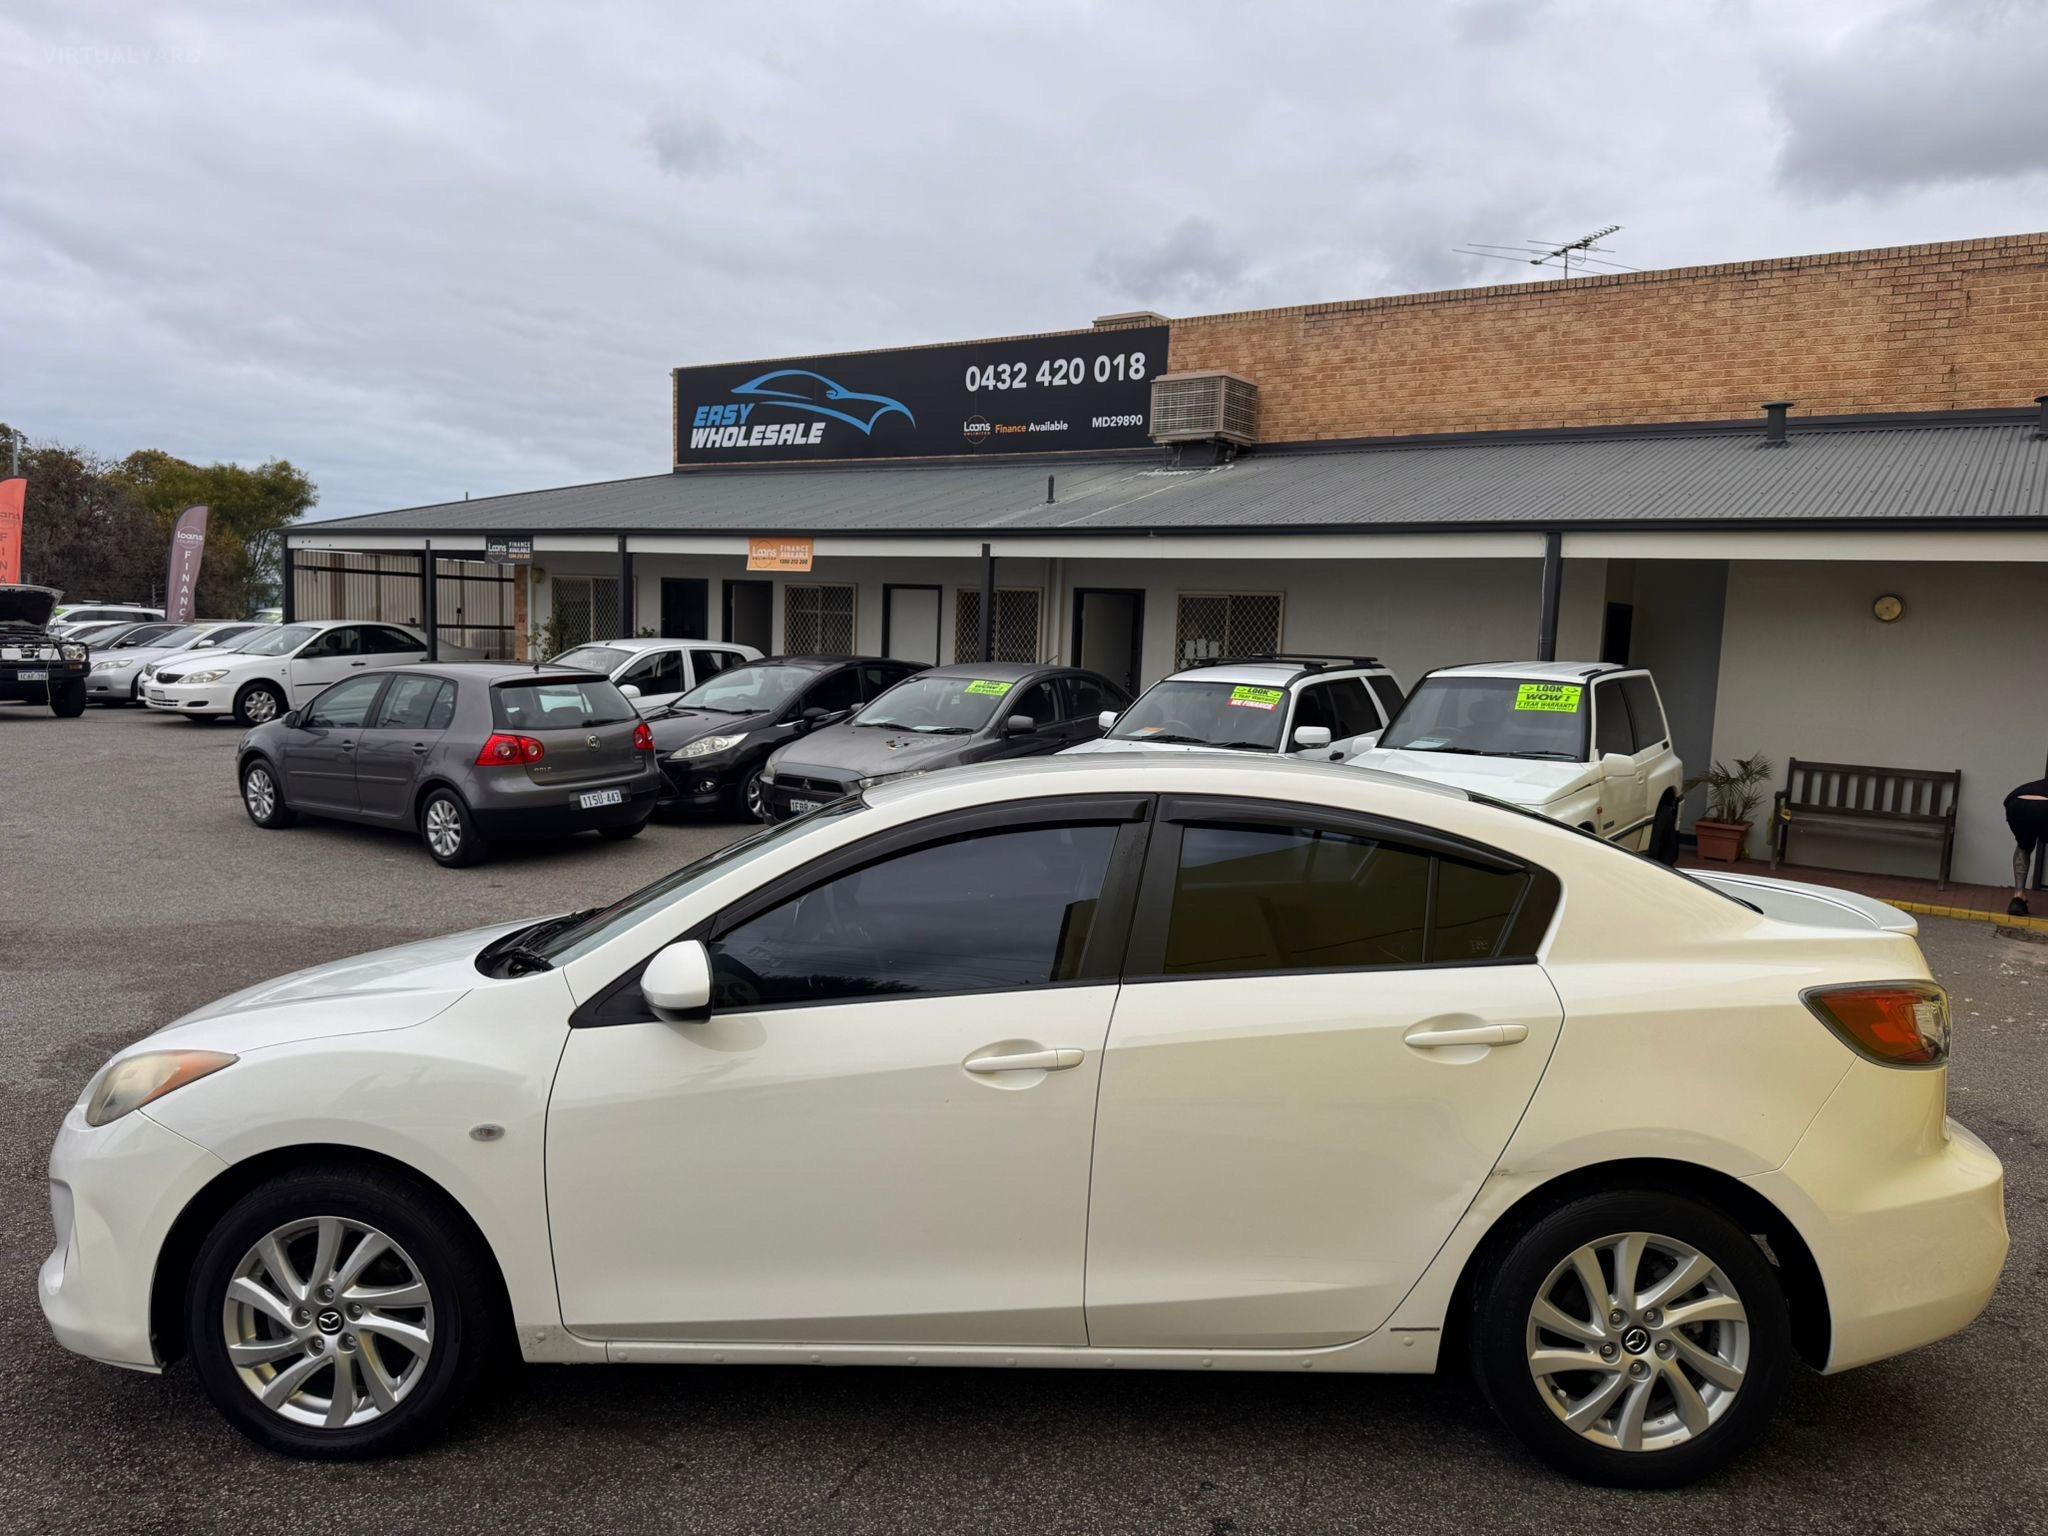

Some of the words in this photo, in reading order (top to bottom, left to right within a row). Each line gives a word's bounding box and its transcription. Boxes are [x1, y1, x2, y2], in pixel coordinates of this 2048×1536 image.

[965, 361, 1027, 392] 0432
[1035, 356, 1085, 387] 420
[1094, 352, 1146, 383] 018
[693, 403, 755, 427] EASY
[1092, 414, 1143, 428] MD29890
[963, 421, 991, 432] Loans
[995, 424, 1027, 433] Finance
[1028, 420, 1068, 432] Available
[690, 422, 826, 449] WHOLESALE
[1536, 685, 1564, 693] LOOK
